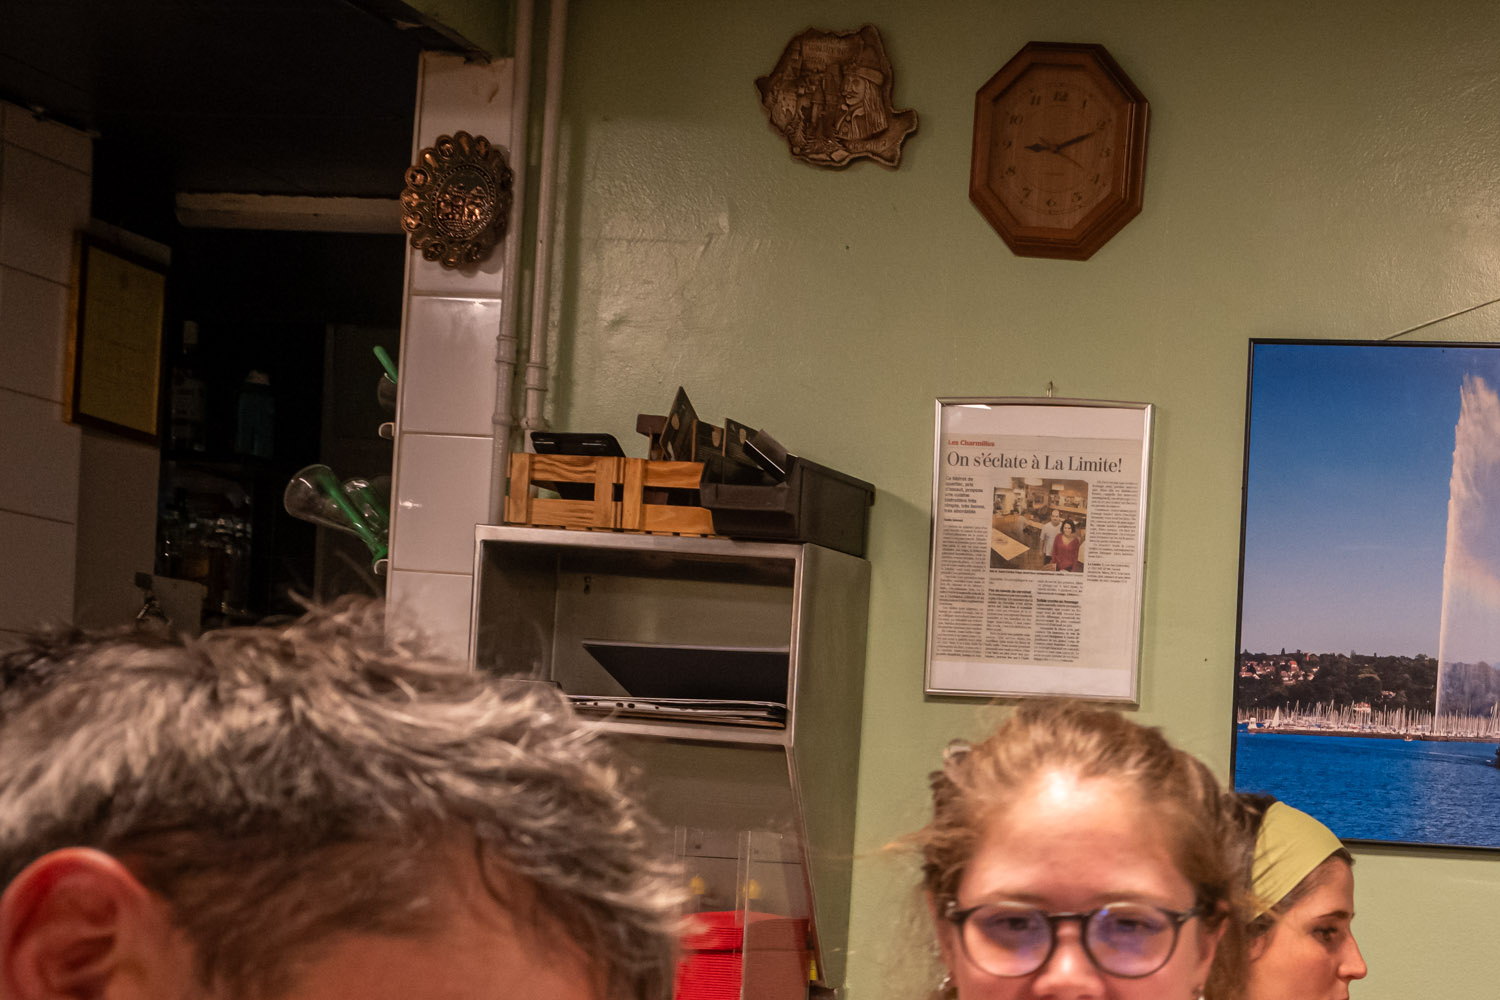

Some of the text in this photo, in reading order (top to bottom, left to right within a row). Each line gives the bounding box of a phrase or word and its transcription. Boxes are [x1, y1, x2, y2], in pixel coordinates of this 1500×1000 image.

[947, 451, 969, 467] On
[1031, 455, 1040, 470] à
[1044, 455, 1064, 471] La
[1068, 456, 1122, 473] Limite!
